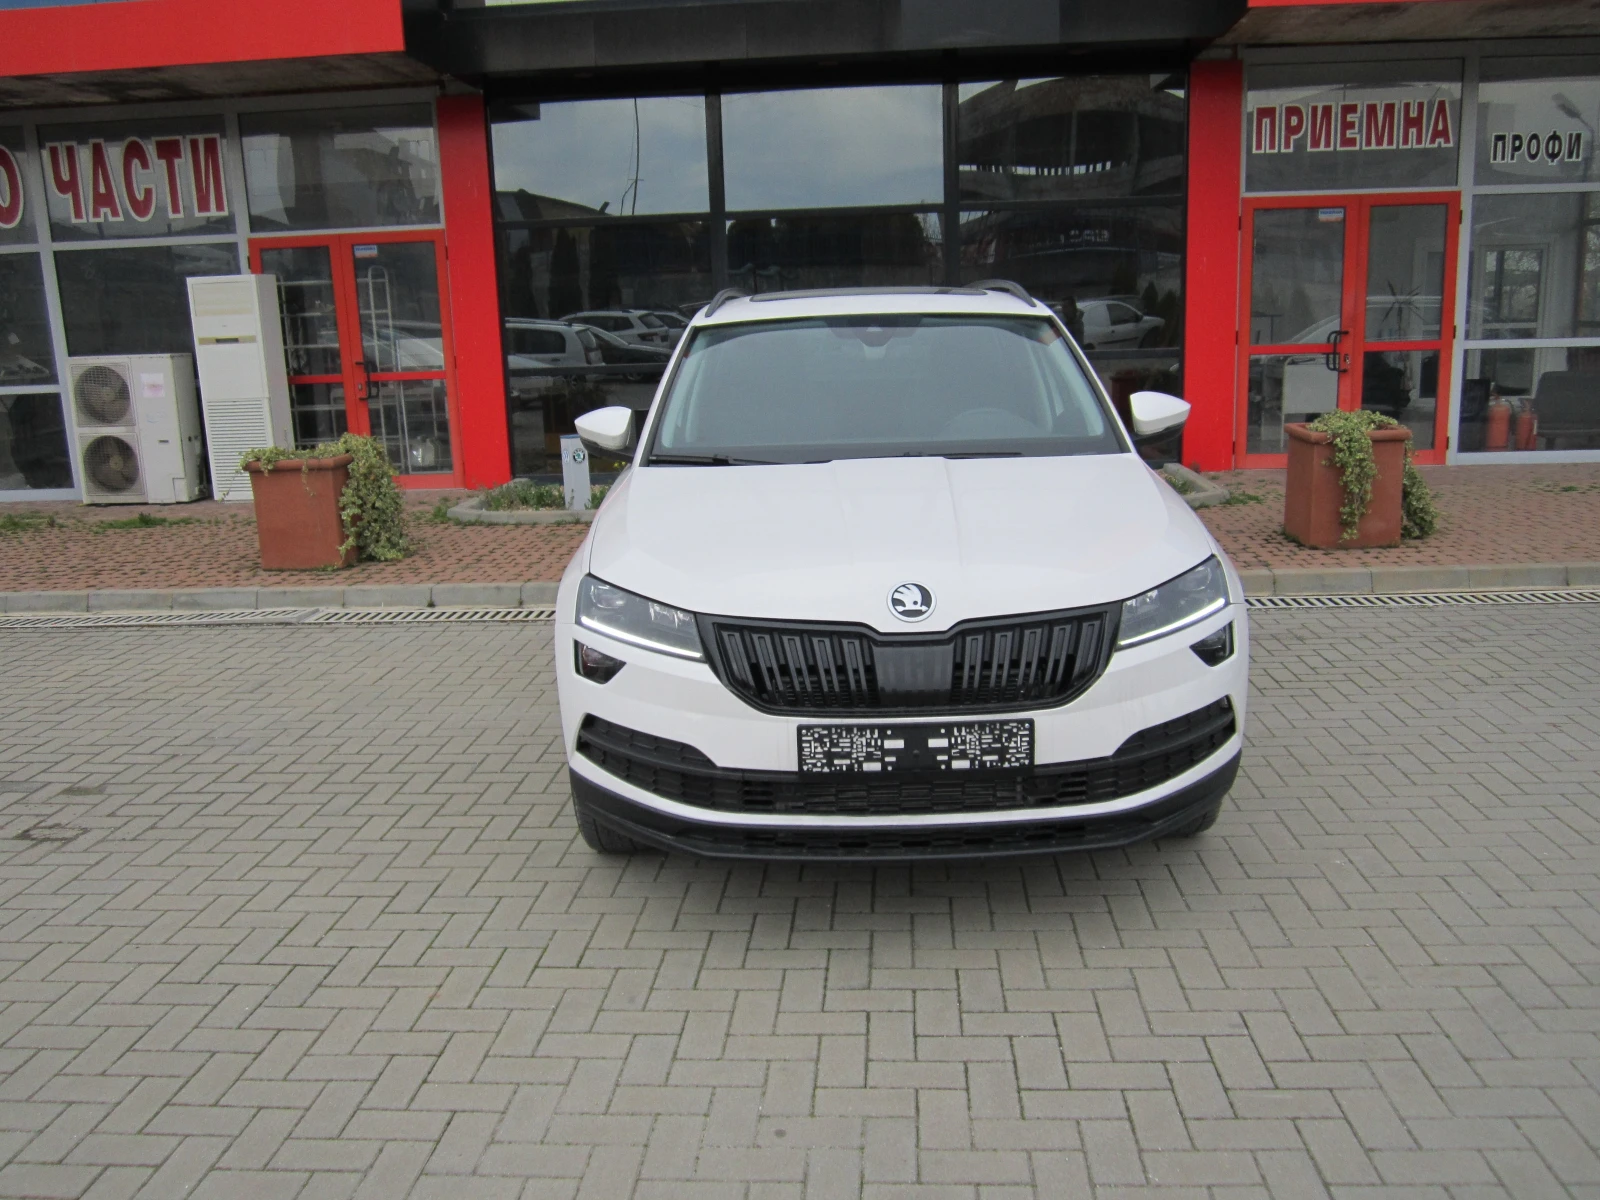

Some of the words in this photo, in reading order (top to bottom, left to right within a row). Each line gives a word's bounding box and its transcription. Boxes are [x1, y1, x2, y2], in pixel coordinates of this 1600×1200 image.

[1252, 98, 1454, 154] ПРИЕМНА
[1490, 130, 1583, 165] ПРОФИ
[46, 133, 229, 223] ЧАСТИ
